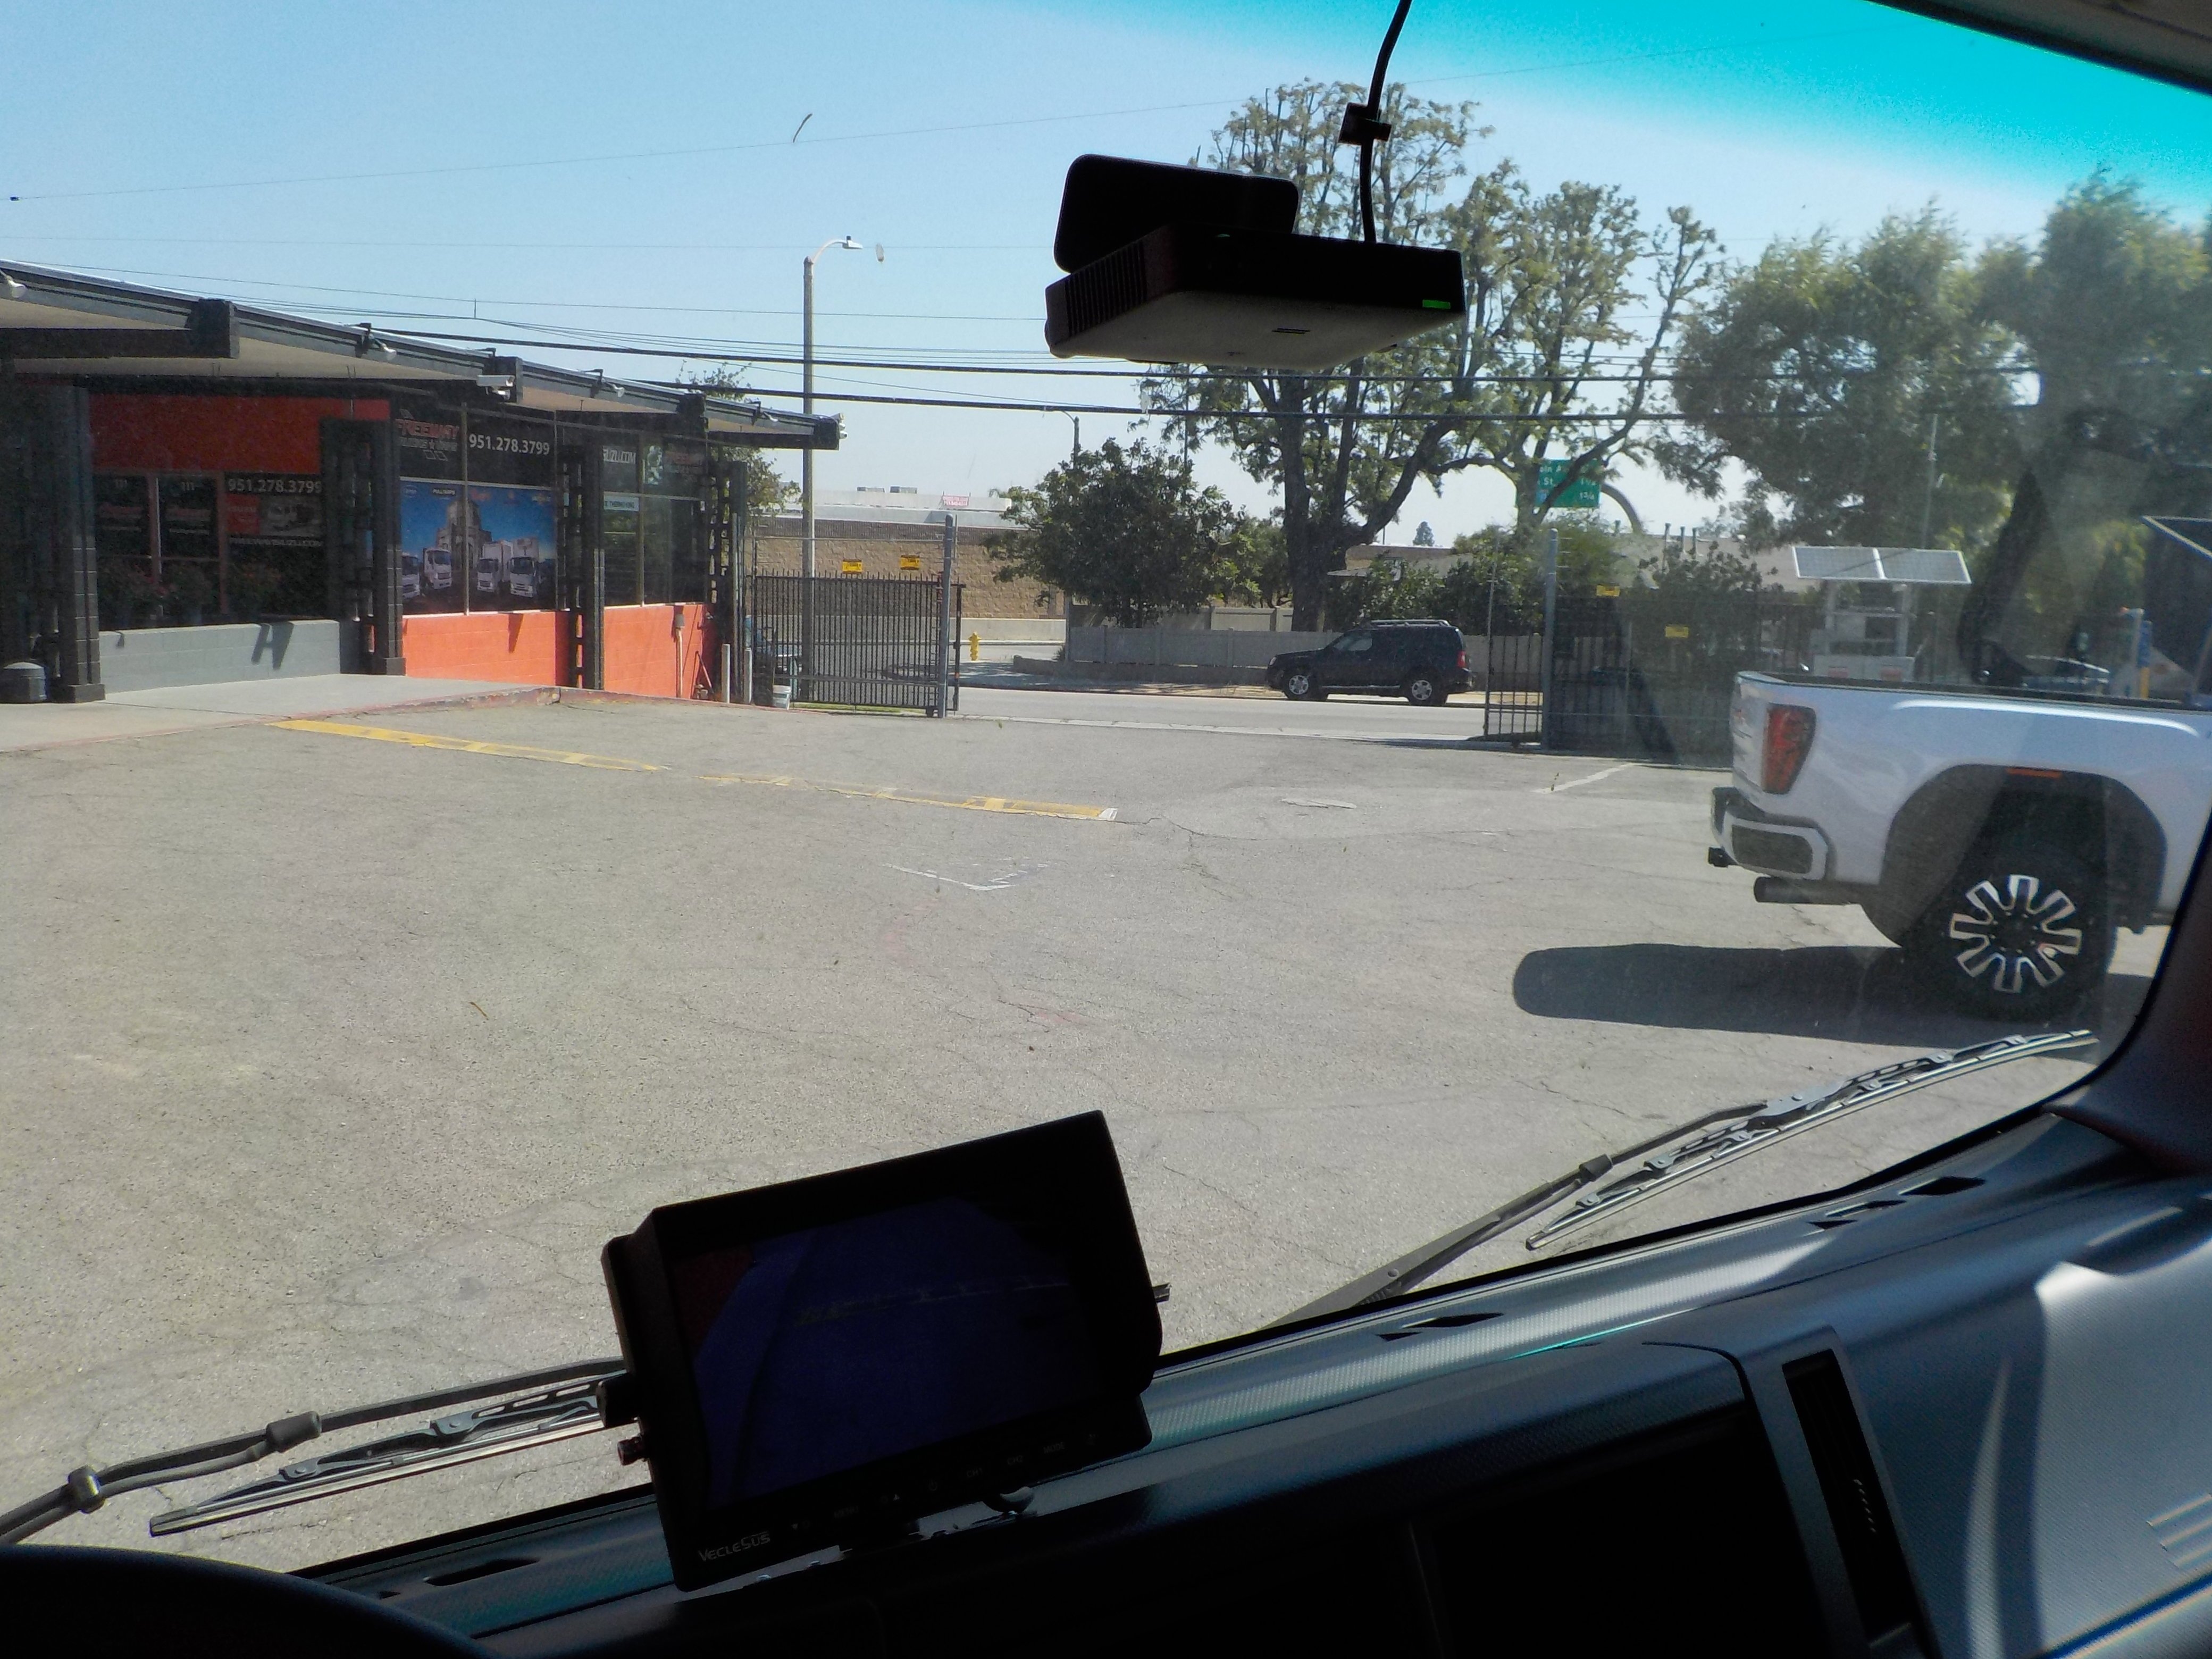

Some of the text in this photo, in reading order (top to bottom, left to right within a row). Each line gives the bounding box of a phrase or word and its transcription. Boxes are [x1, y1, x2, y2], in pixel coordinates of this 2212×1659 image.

[395, 418, 459, 440] FREEWAY
[468, 433, 550, 456] 951.278.3799
[228, 478, 322, 494] 951.278.3799
[1006, 1454, 1024, 1467] CH2
[965, 1467, 983, 1479] CH1
